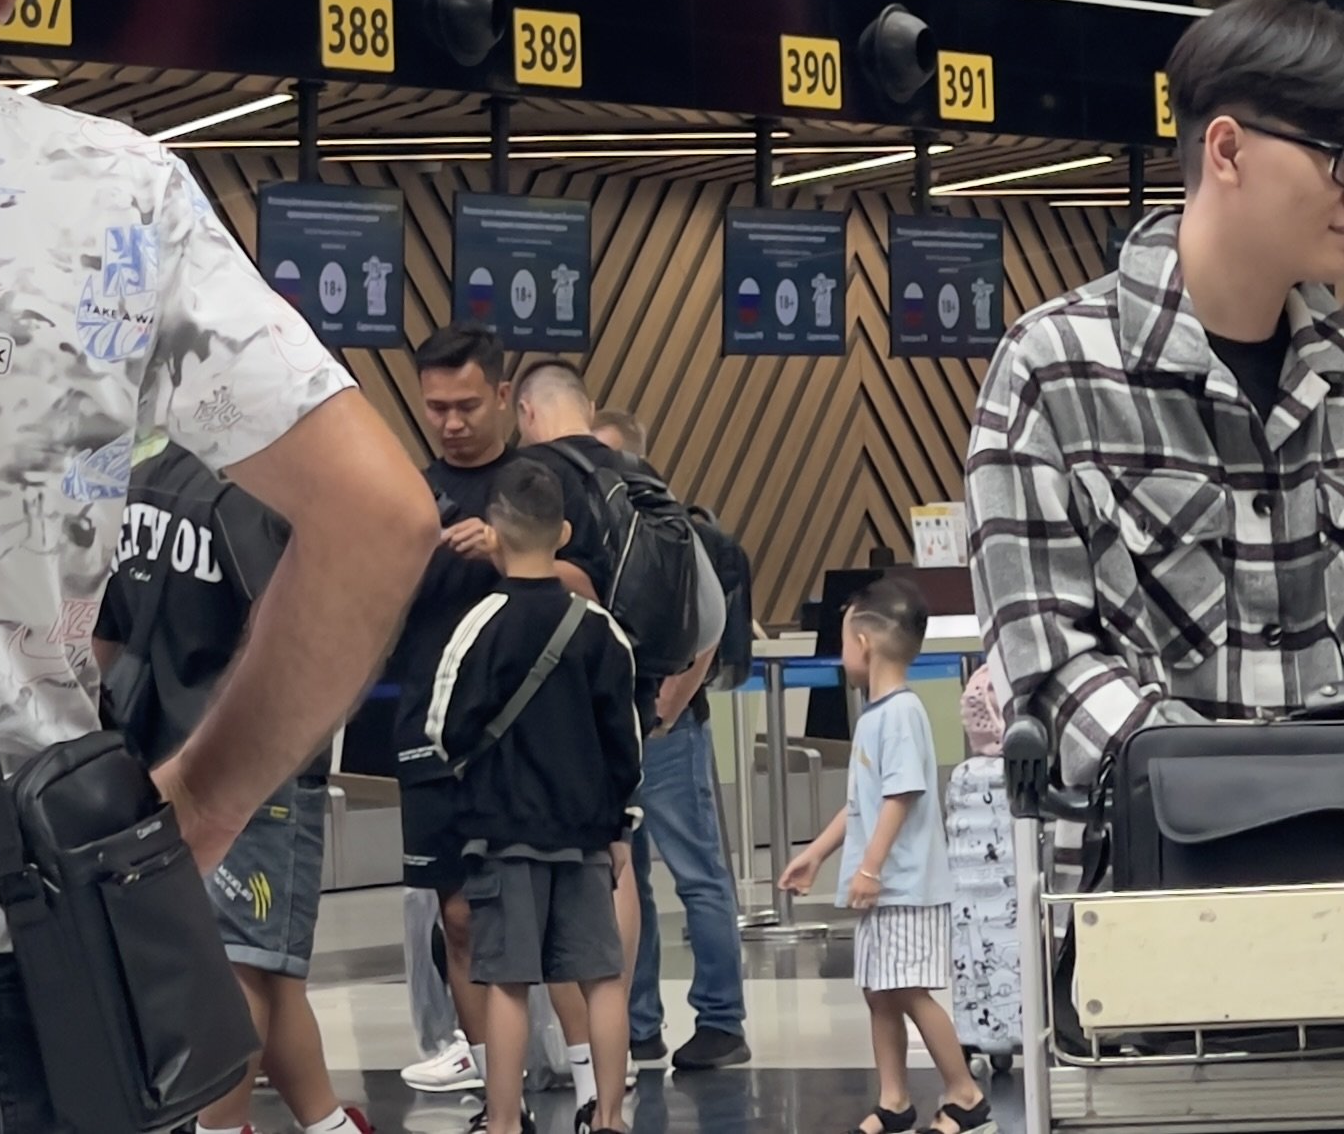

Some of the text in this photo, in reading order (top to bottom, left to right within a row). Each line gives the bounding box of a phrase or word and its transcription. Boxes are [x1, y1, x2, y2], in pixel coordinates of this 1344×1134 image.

[327, 4, 391, 59] 388
[520, 22, 577, 74] 389
[787, 48, 837, 96] 390
[944, 63, 987, 109] 391
[85, 301, 119, 321] TAKE
